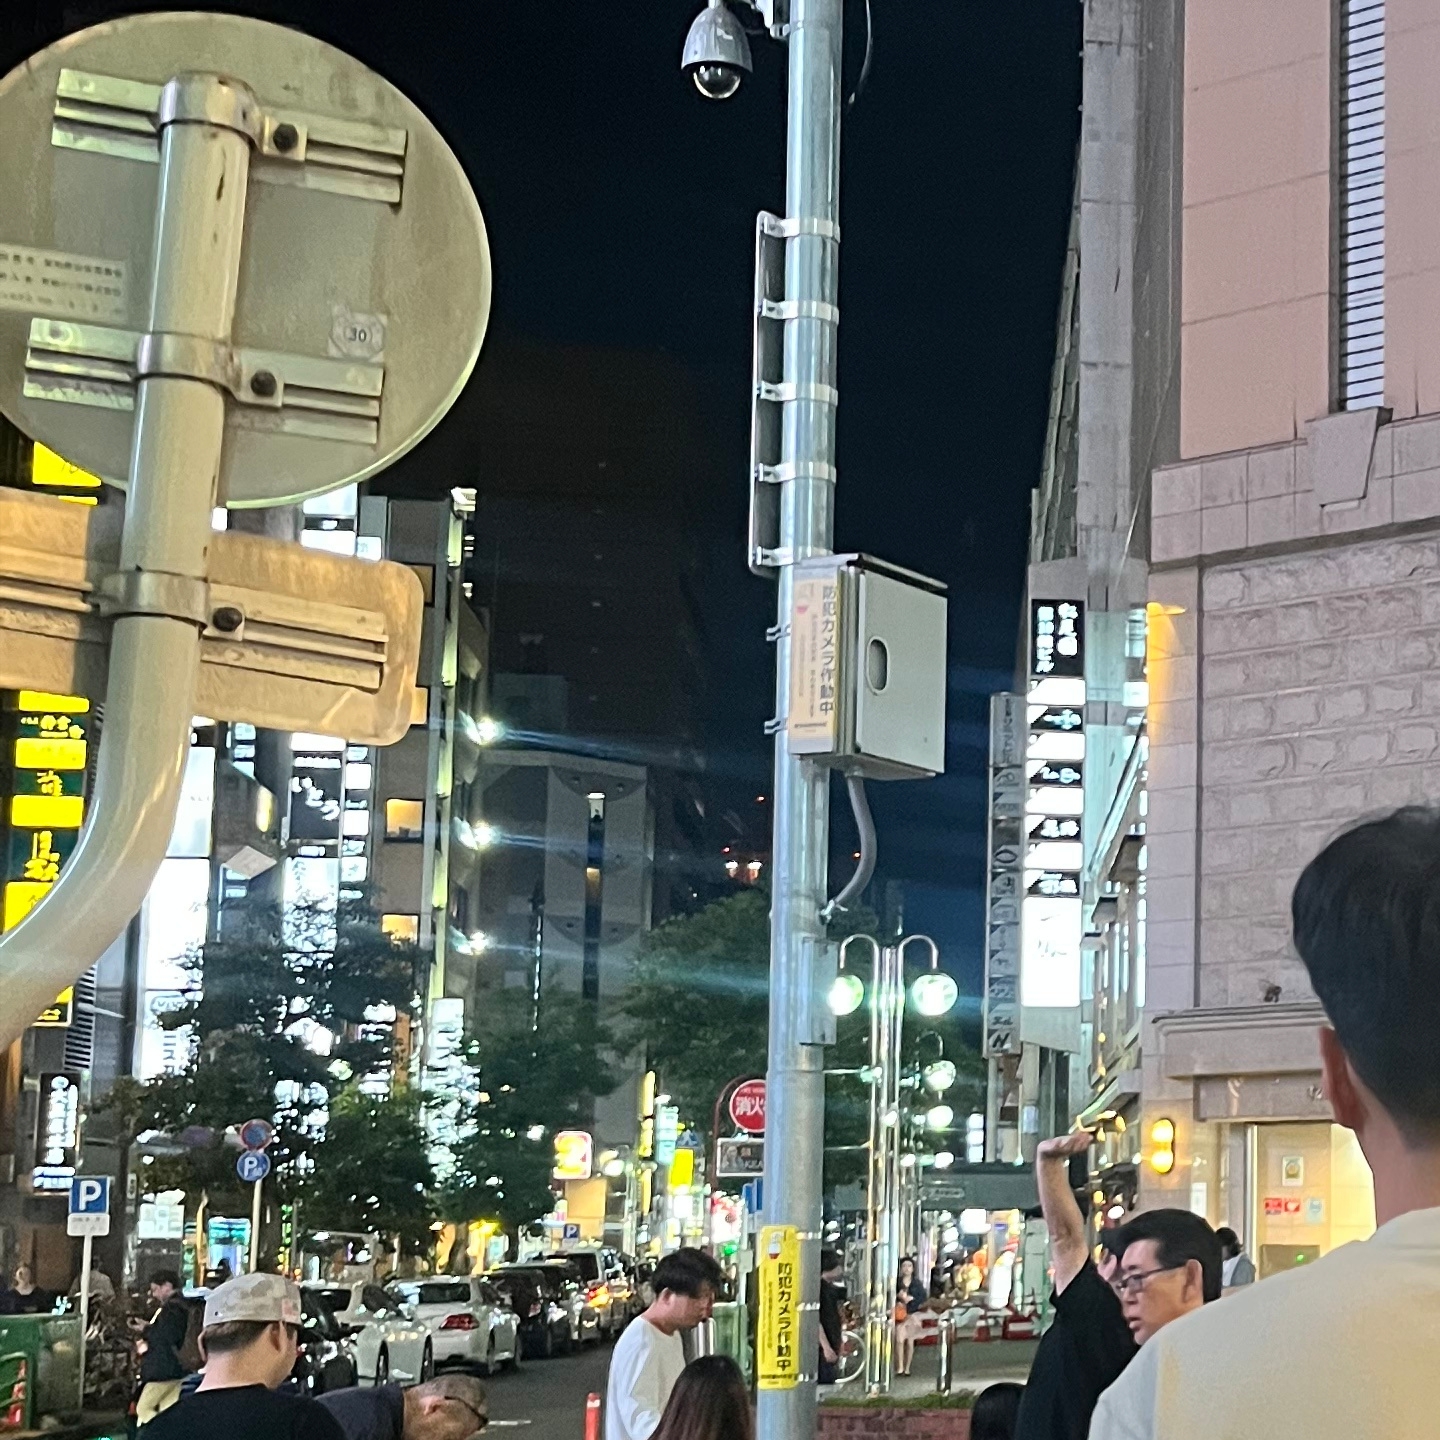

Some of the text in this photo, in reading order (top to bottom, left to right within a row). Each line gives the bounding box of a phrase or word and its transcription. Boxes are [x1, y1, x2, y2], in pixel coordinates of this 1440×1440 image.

[735, 1096, 766, 1116] 消火
[78, 1179, 102, 1211] P
[776, 1262, 793, 1372] 防犯カメラ作動中
